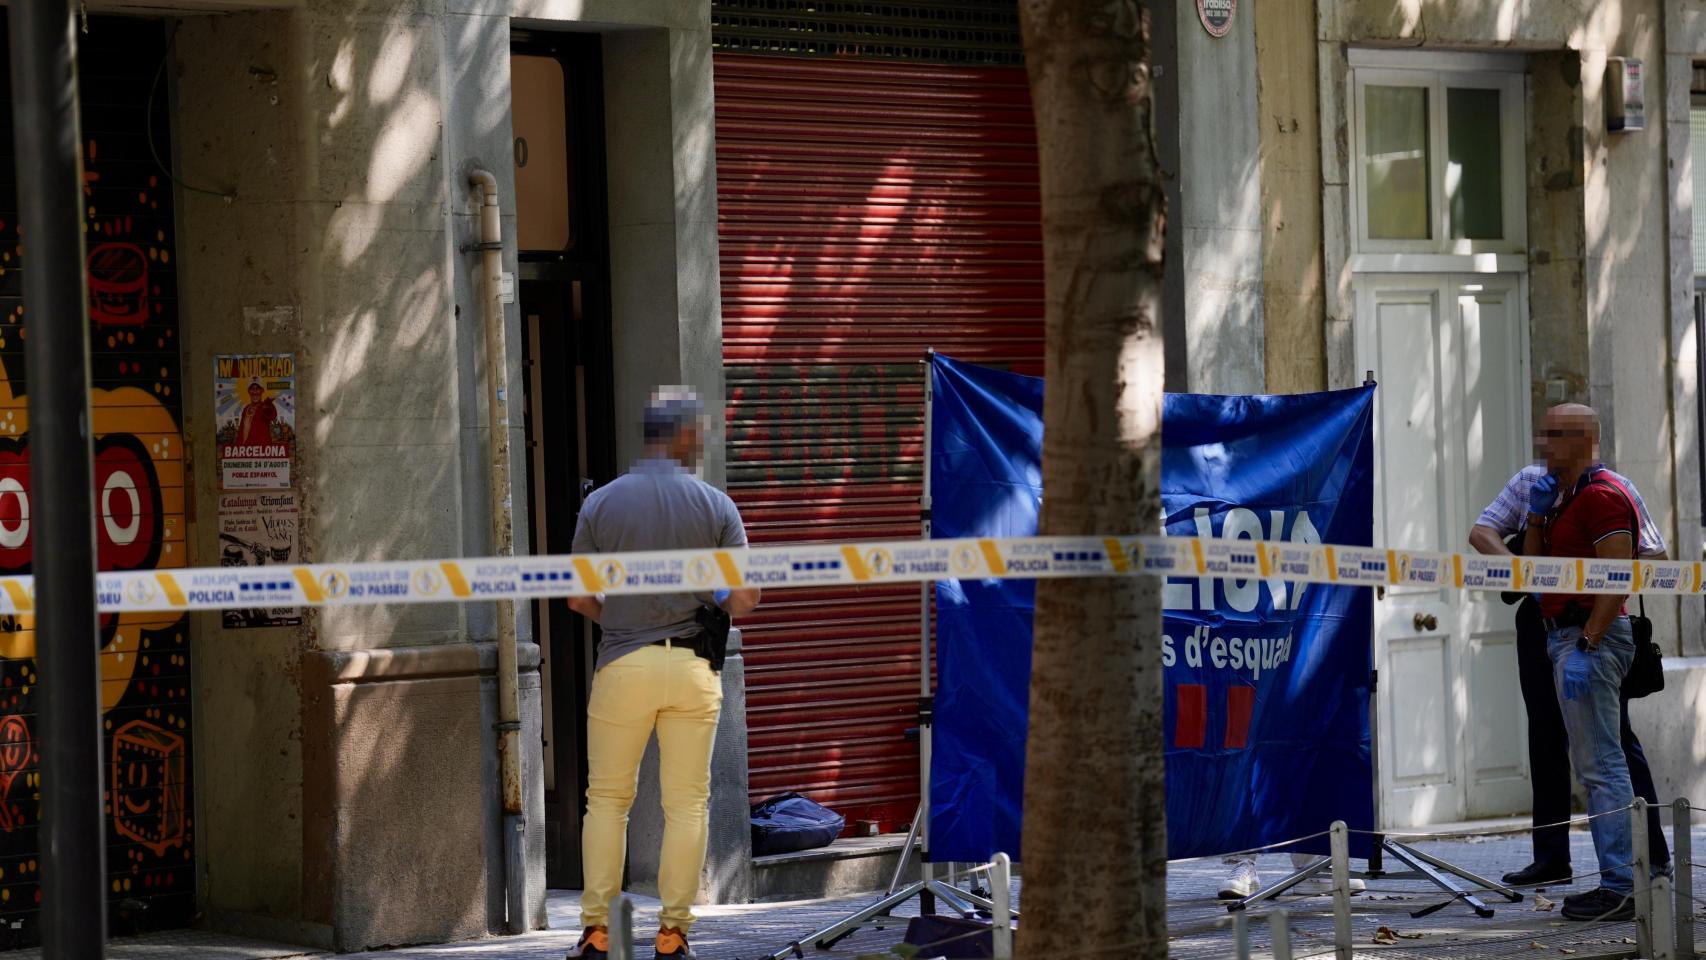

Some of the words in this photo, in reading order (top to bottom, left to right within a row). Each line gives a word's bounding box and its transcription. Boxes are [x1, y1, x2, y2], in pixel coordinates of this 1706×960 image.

[258, 356, 292, 378] CHAO
[224, 445, 287, 459] BARCELONA
[263, 461, 289, 469] D'AGOST
[222, 496, 257, 509] Catalunya
[261, 495, 294, 508] Triomfant
[893, 563, 906, 573] NO
[910, 562, 948, 572] PASSEU
[1007, 560, 1049, 571] POLICIA
[1206, 560, 1228, 572] POLICIA
[1280, 563, 1288, 573] NO
[745, 571, 787, 582] POLICIA
[1338, 567, 1359, 579] POLICIA
[1409, 570, 1417, 580] NO
[1418, 570, 1437, 583] PASSEU
[626, 575, 639, 585] NO
[643, 573, 681, 584] PASSEU
[1463, 575, 1484, 586] POLICIA
[1531, 576, 1540, 586] NO
[1540, 576, 1559, 587] PASSEU
[1584, 578, 1605, 589] POLICIA
[1650, 578, 1659, 588] NO
[1659, 579, 1678, 589] PASSEU
[349, 585, 364, 596] NO
[368, 583, 408, 595] PASSEU
[471, 581, 516, 593] POLICIA
[98, 593, 121, 604] SEU
[189, 591, 234, 602] POLICIA
